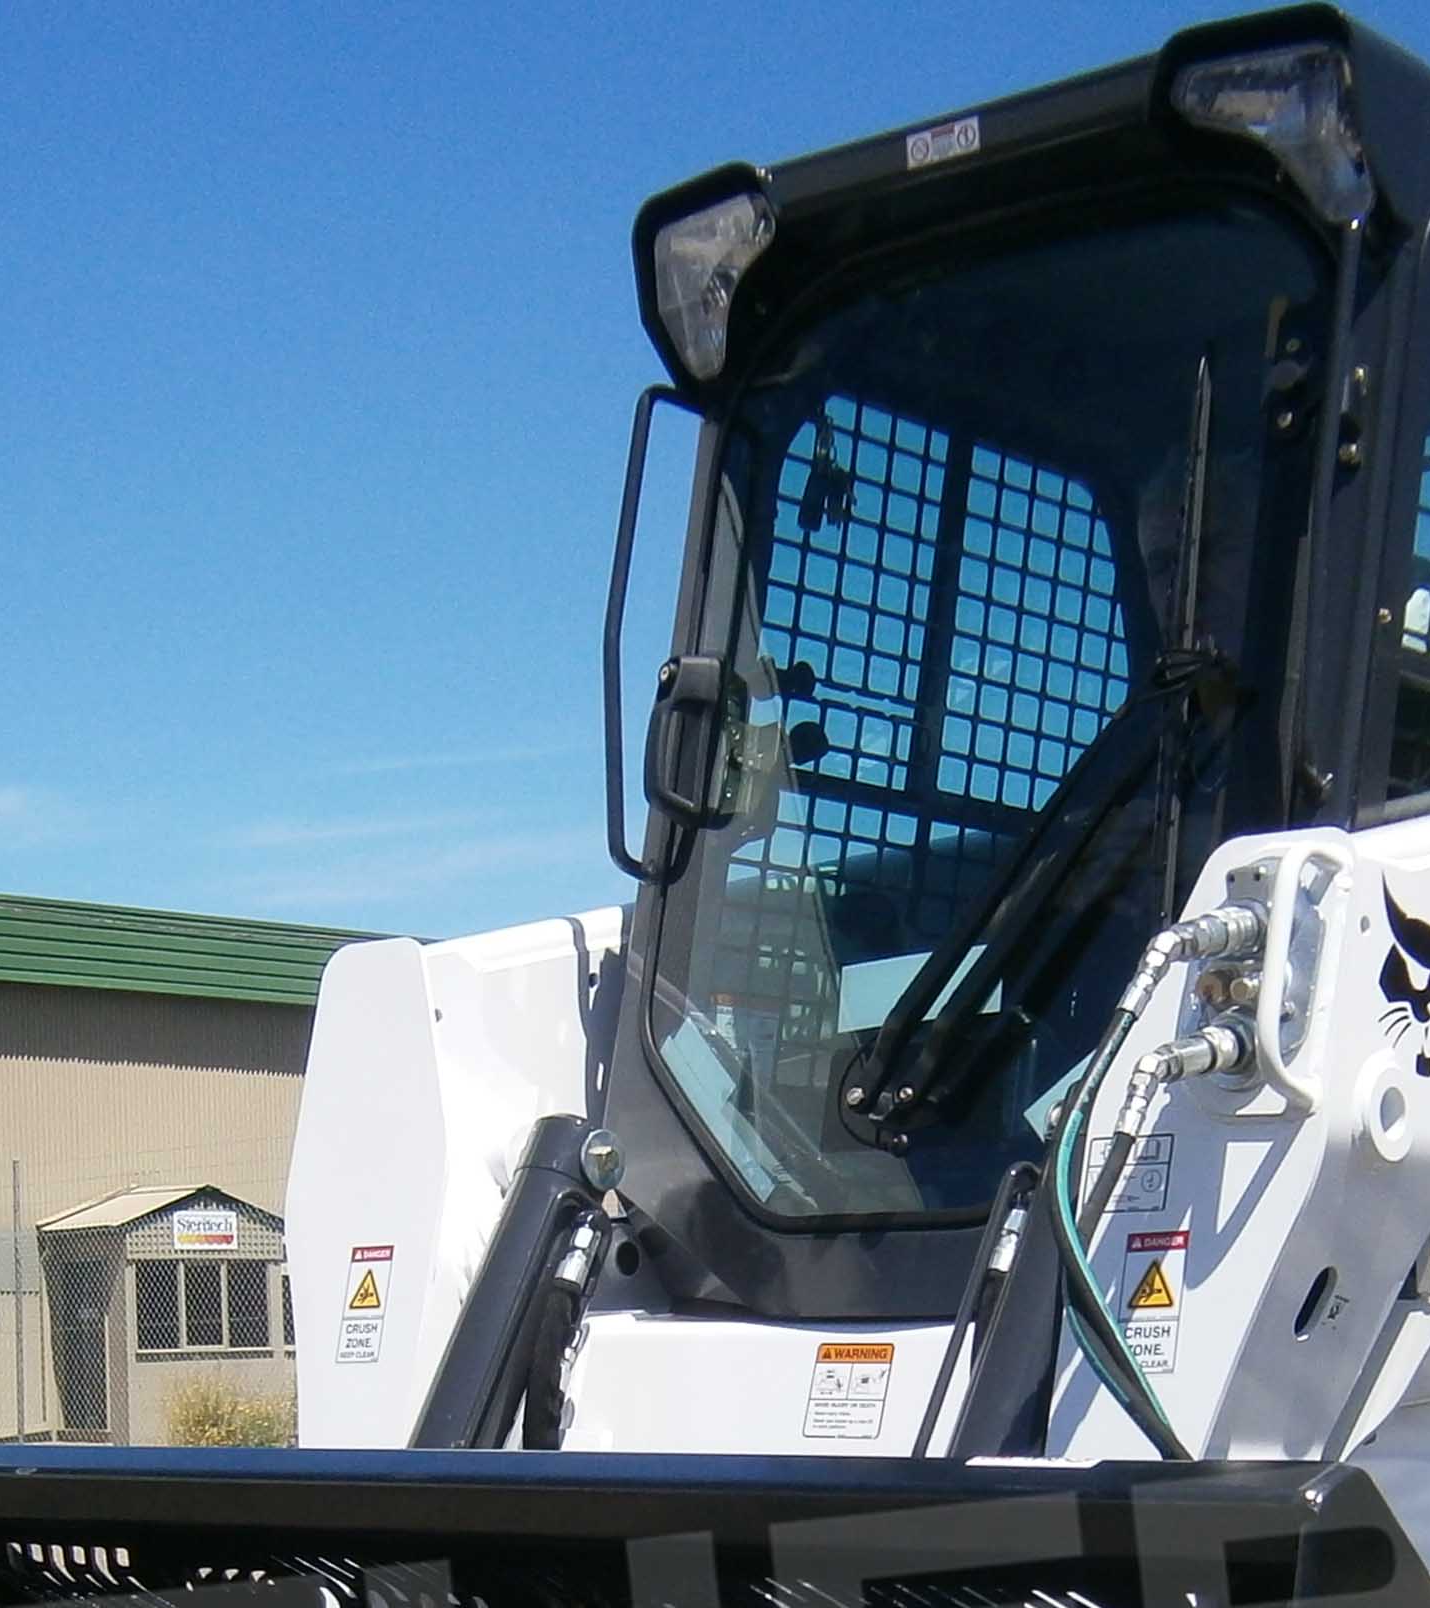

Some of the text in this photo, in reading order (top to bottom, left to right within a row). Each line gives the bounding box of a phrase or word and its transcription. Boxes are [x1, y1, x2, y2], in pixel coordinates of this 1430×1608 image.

[345, 1323, 379, 1335] CRUSH
[1123, 1325, 1172, 1340] CRUSH
[833, 1347, 889, 1360] WARNING
